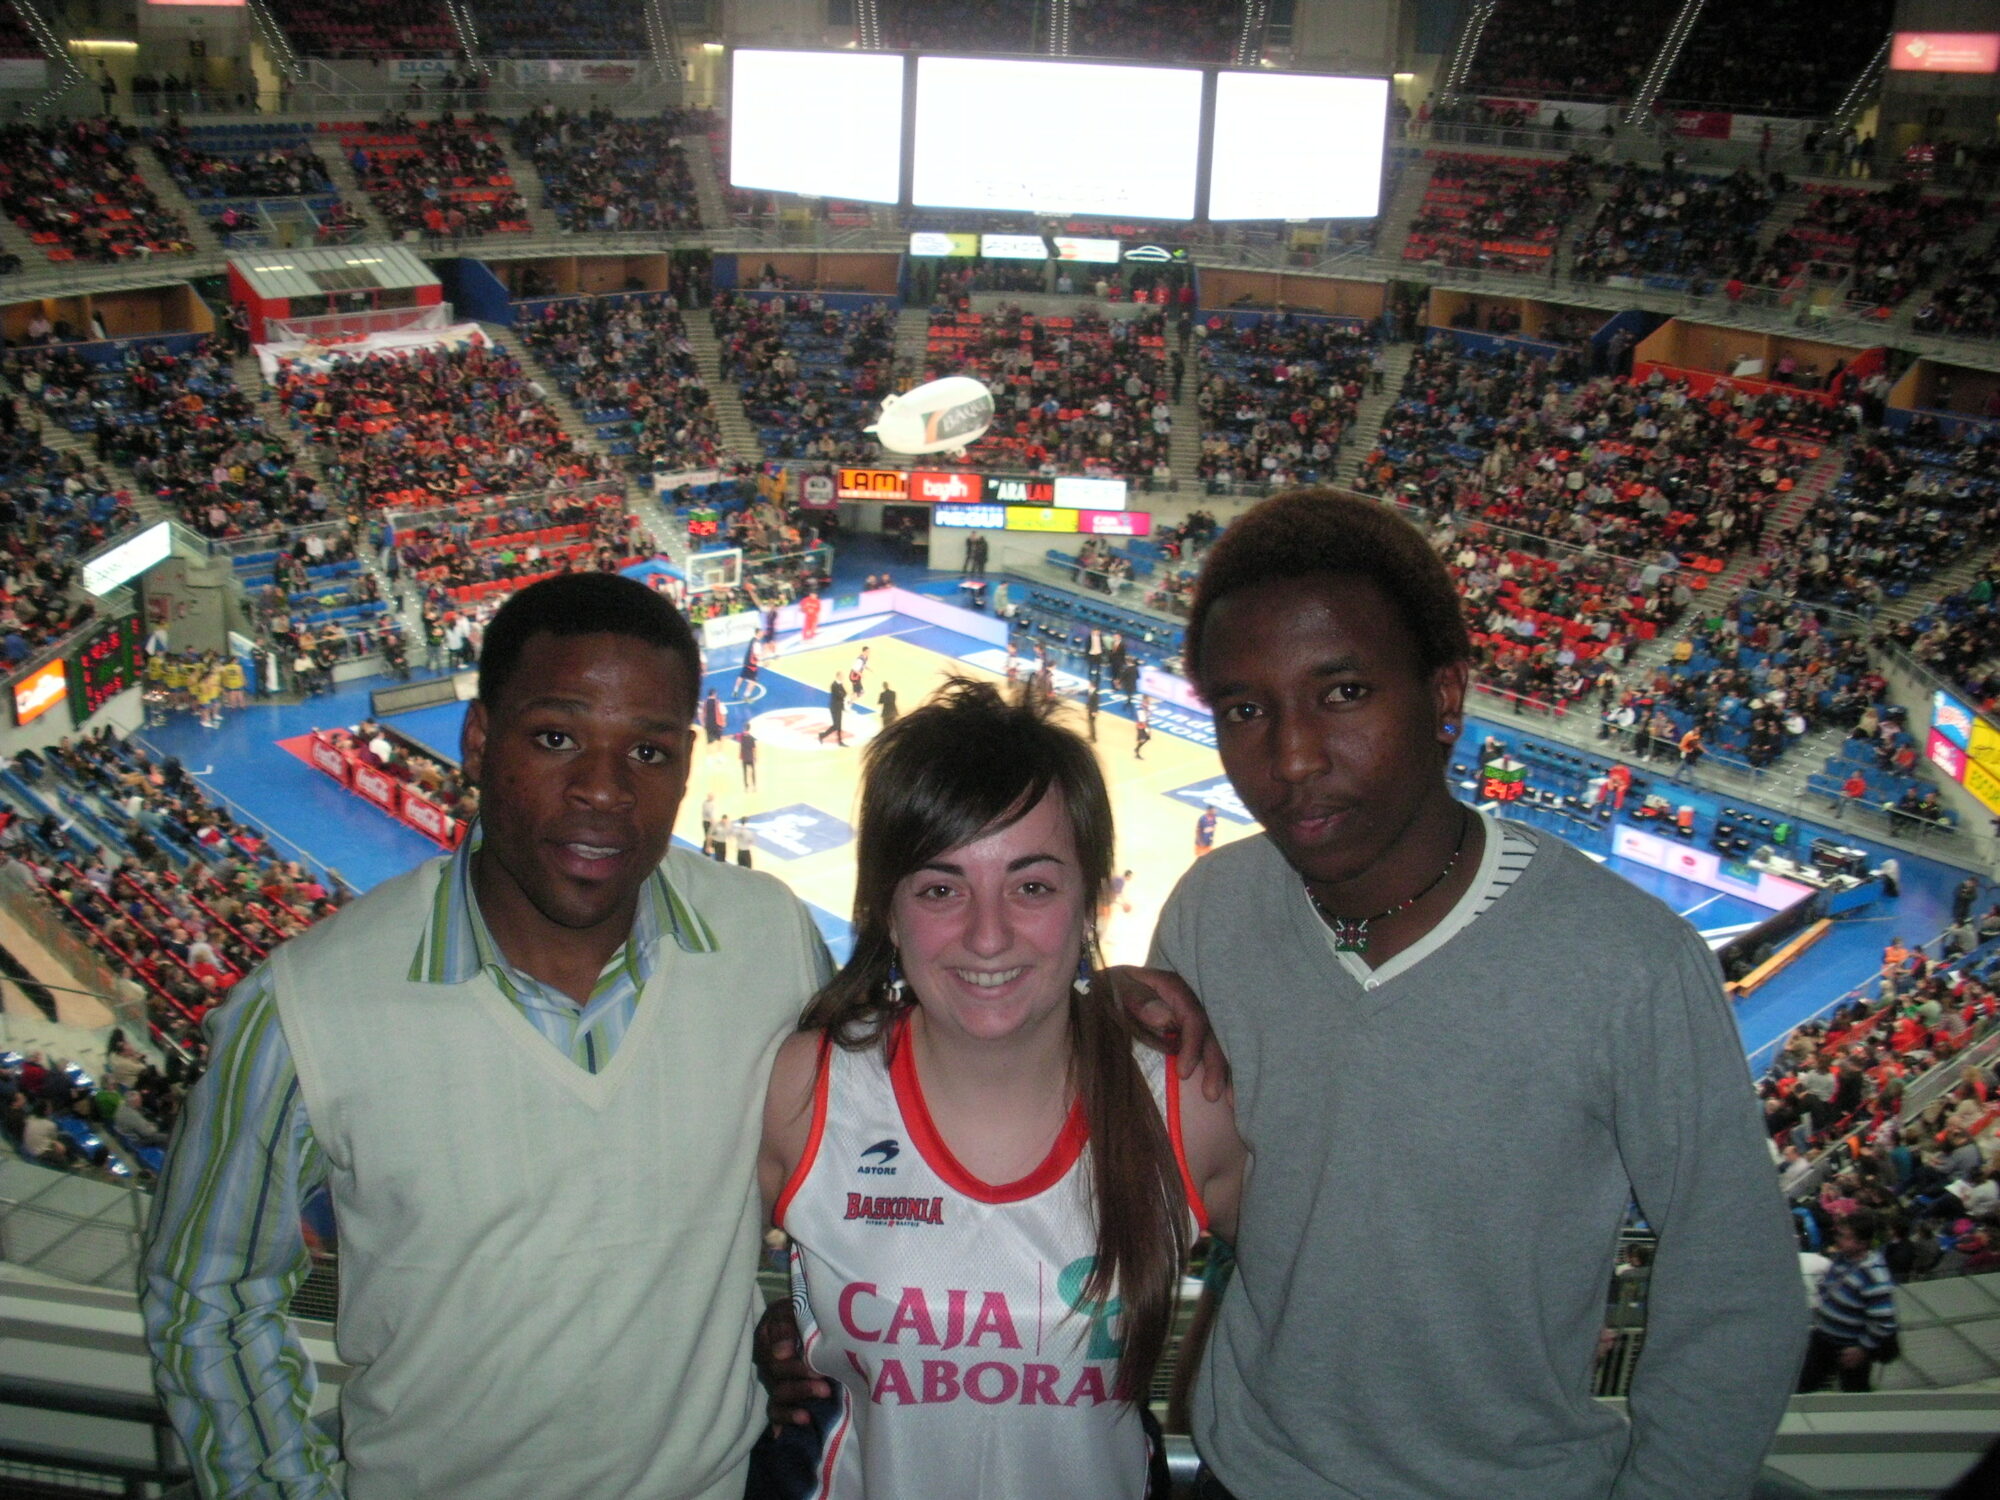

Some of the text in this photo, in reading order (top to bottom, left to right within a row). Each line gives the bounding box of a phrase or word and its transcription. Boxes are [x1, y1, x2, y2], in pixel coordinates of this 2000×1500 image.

[857, 1166, 897, 1175] ASTORE
[843, 1192, 945, 1225] BASKONIA
[838, 1282, 1023, 1351] CAJA
[844, 1349, 1132, 1407] ABORA
